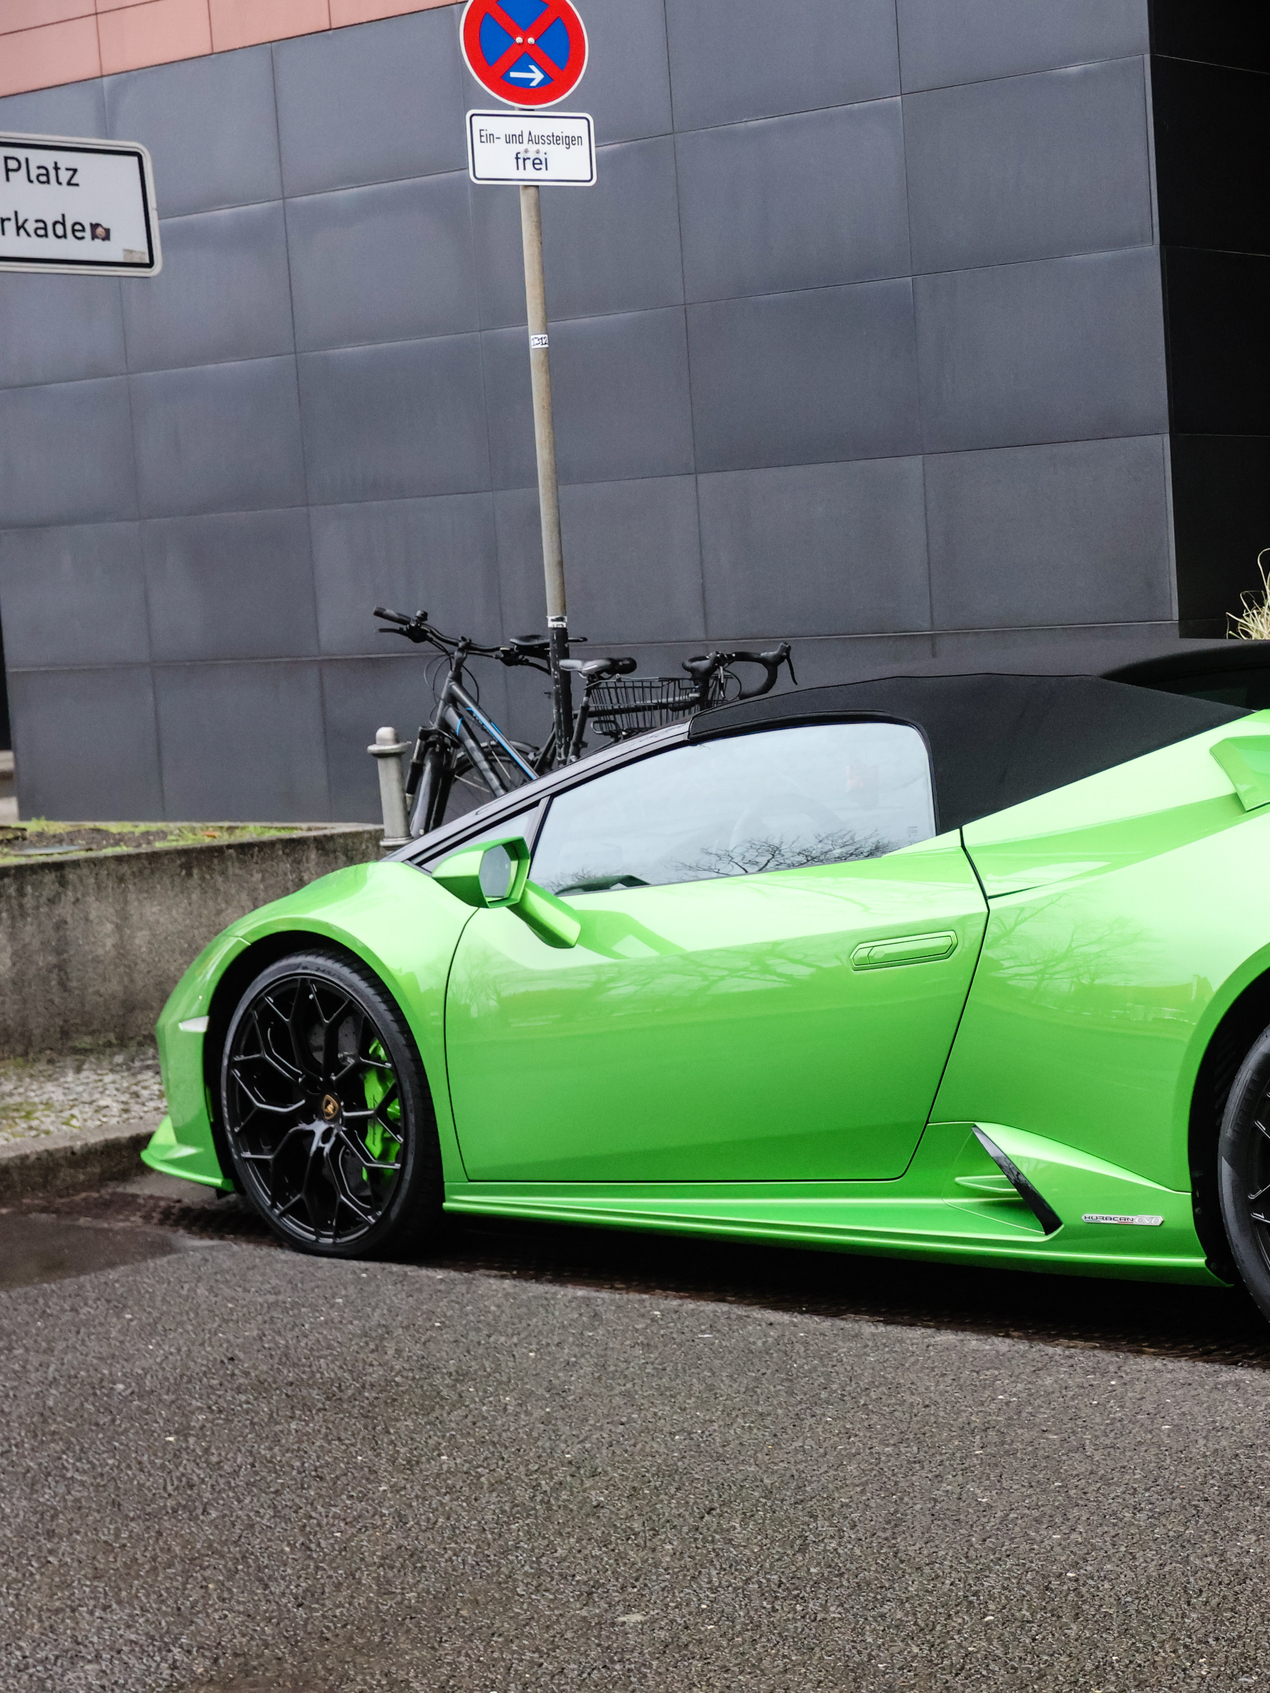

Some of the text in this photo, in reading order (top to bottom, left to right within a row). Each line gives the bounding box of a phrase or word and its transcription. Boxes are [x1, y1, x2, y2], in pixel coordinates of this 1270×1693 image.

[479, 129, 583, 150] Ein- und Aussteigen
[3, 156, 80, 187] Platz
[515, 151, 548, 171] frei
[0, 210, 107, 242] rkaden
